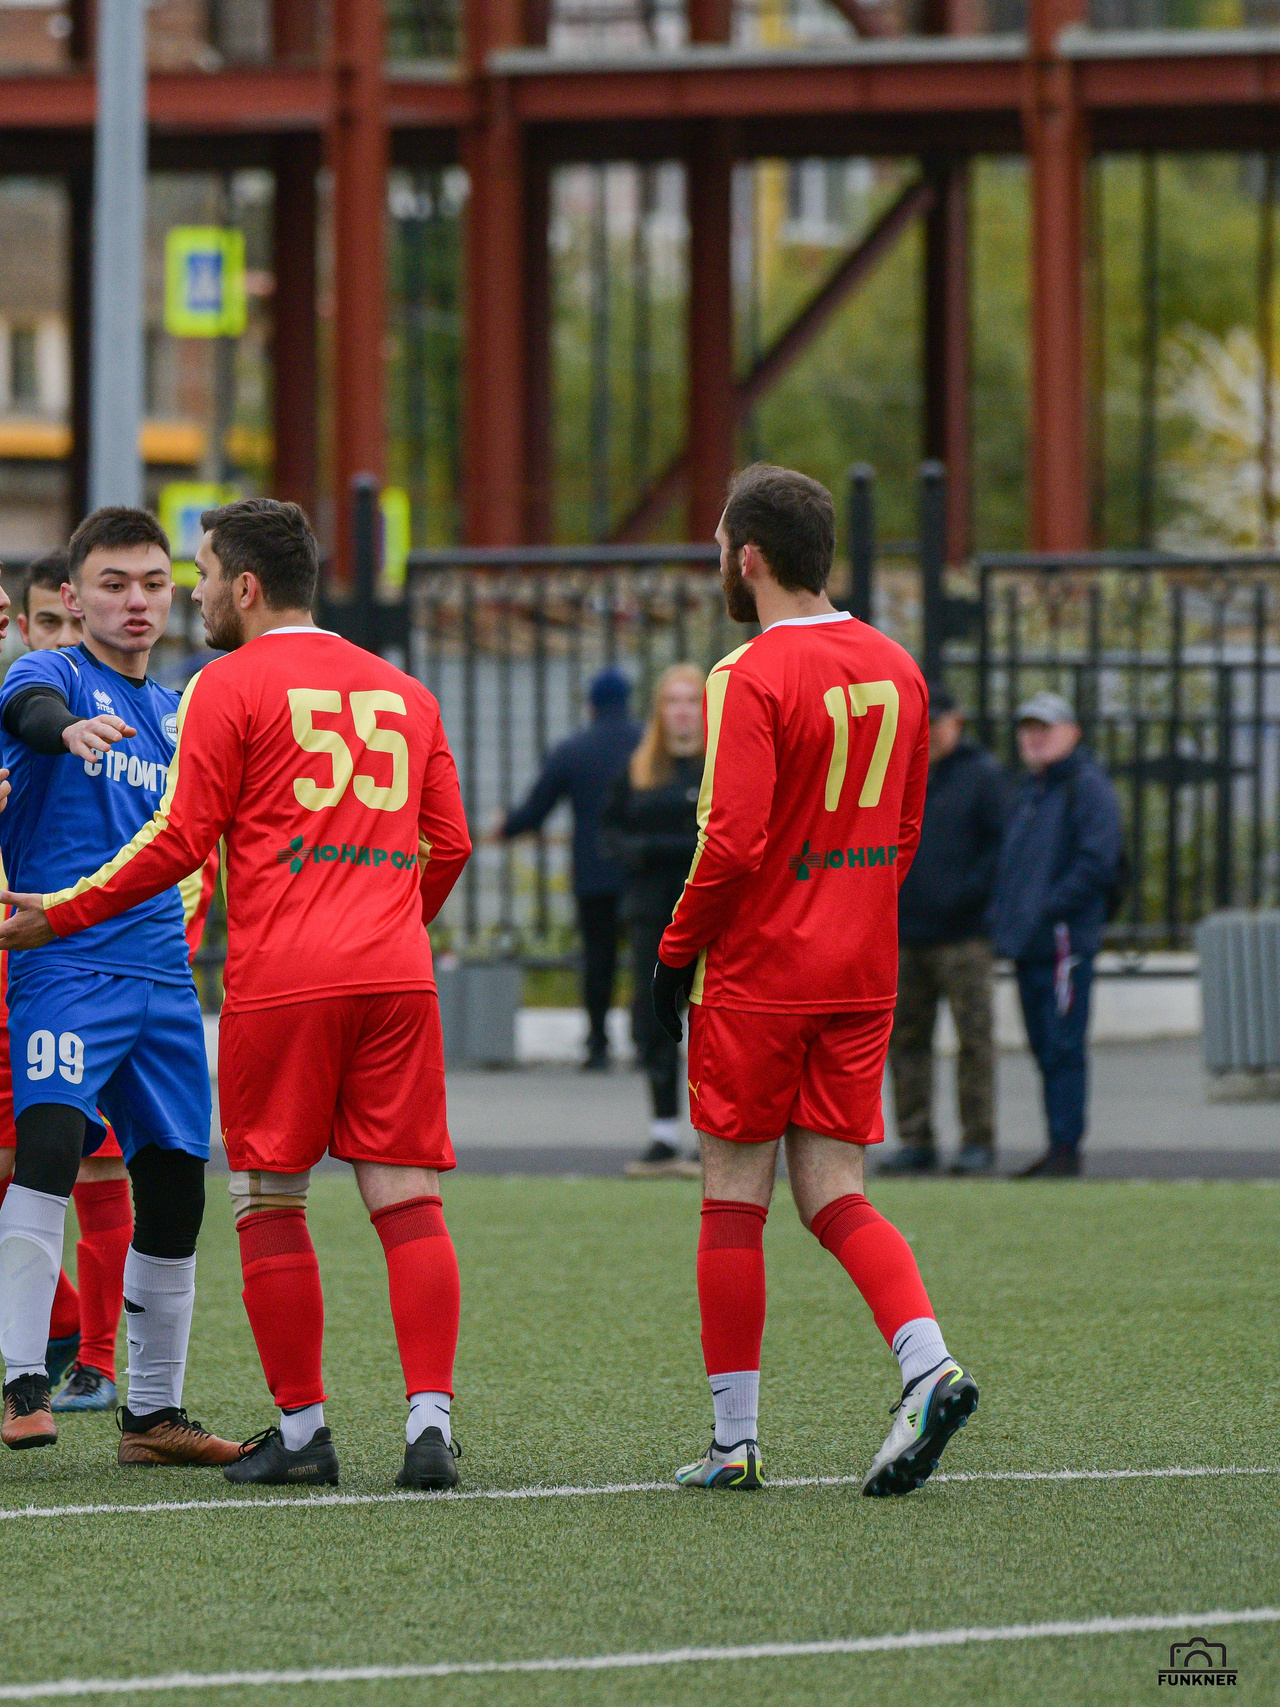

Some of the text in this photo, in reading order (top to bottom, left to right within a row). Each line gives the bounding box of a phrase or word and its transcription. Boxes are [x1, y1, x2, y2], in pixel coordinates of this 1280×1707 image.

[83, 747, 169, 795] СТРОИТ
[287, 688, 410, 812] 55
[823, 680, 900, 812] 17
[823, 845, 899, 870] ЮНИР
[26, 1029, 85, 1085] 99
